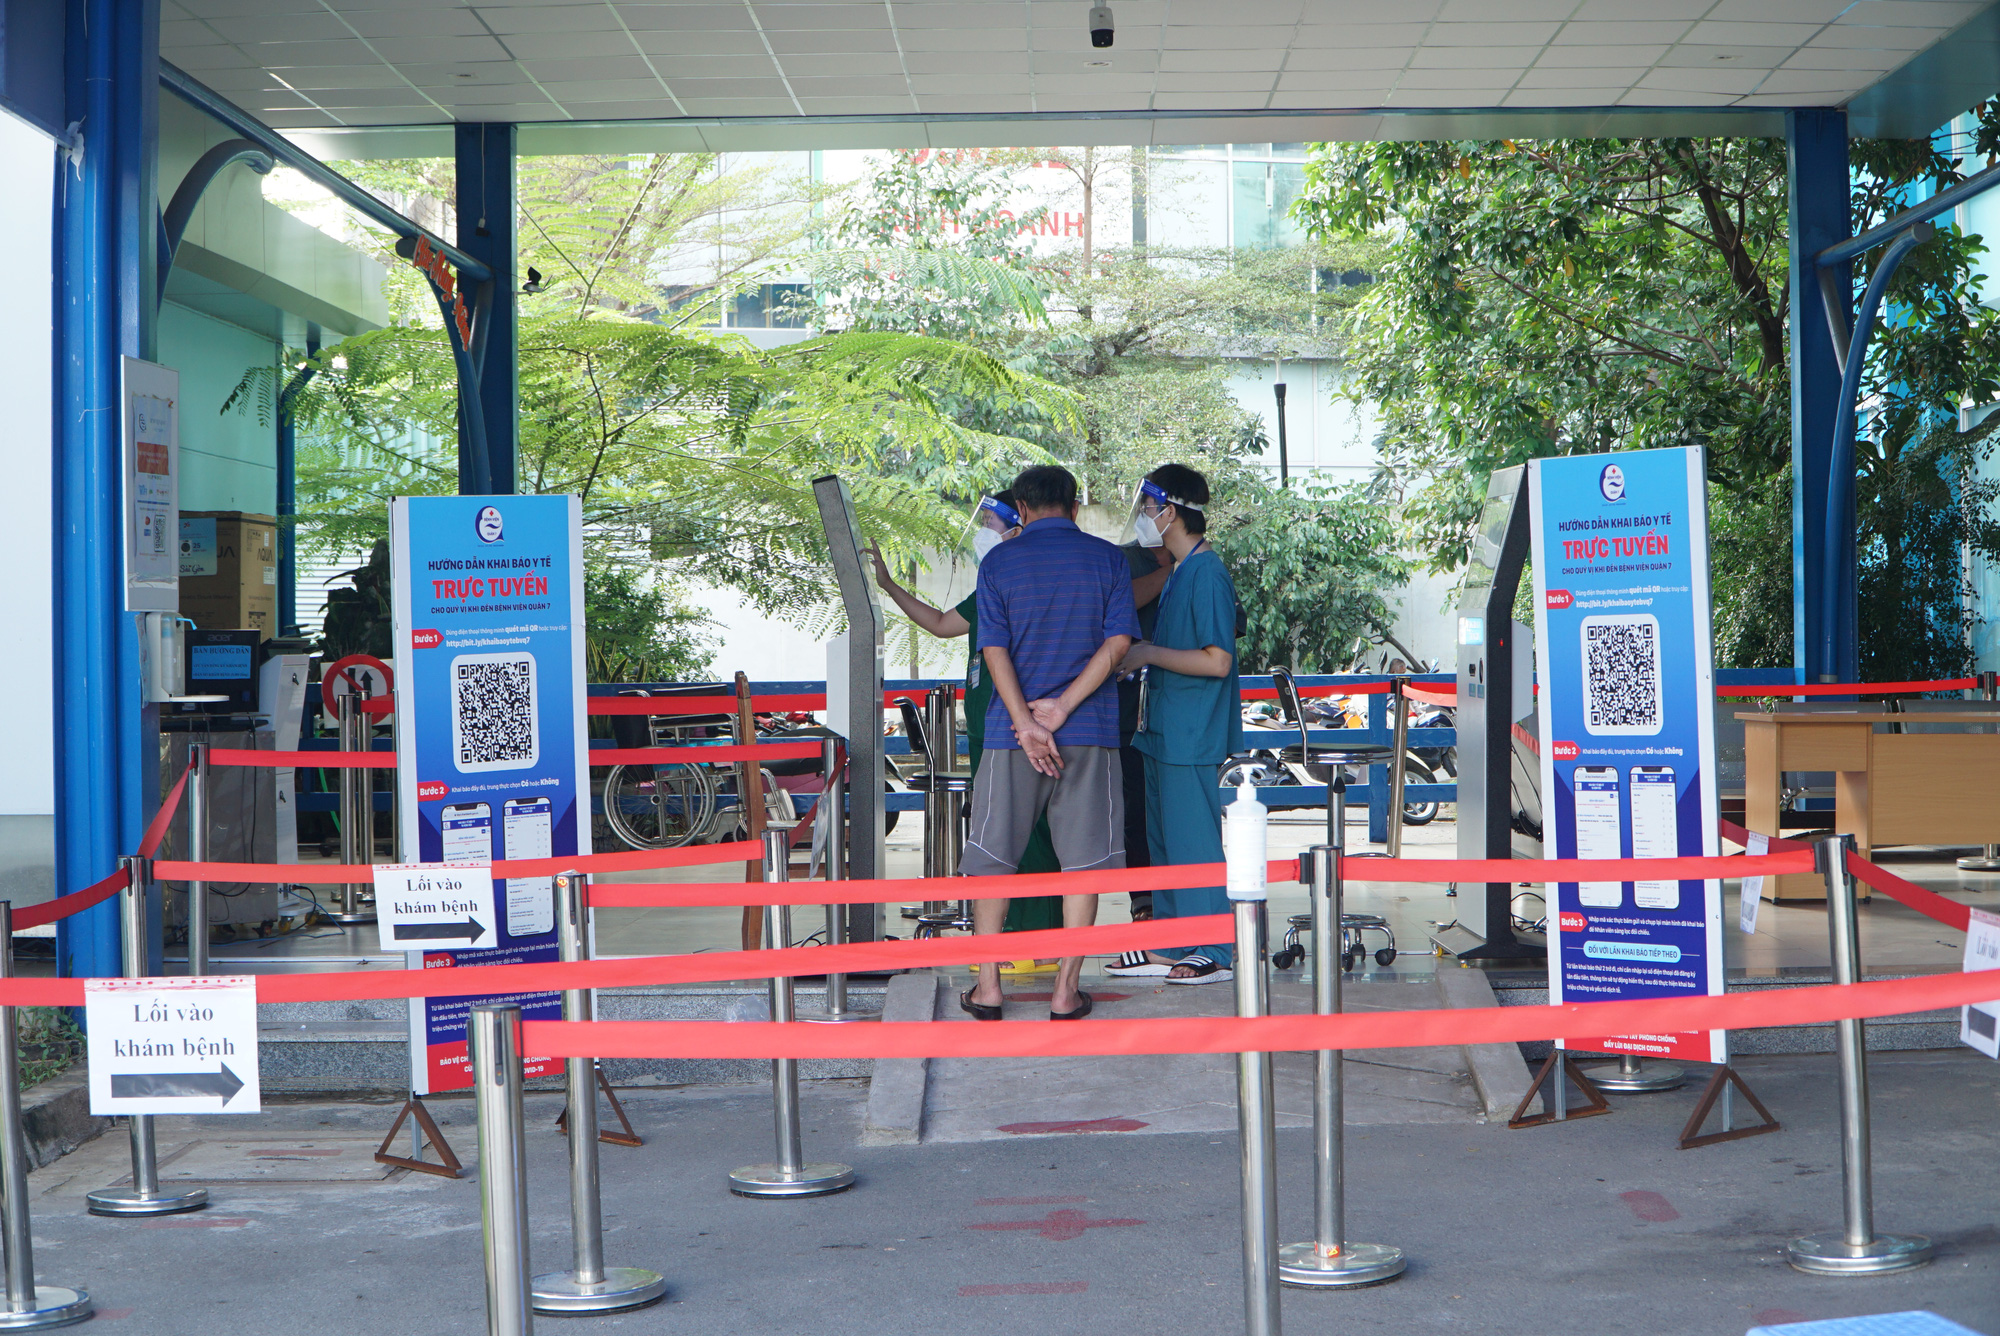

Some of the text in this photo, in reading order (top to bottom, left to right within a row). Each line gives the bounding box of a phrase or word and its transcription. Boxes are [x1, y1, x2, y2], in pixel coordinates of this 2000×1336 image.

[1559, 511, 1672, 532] HƯỚNG DẪN KHAI BÁO Y TẾ
[1562, 528, 1669, 564] TRỰC TUYẾN
[257, 547, 273, 562] AQUA
[428, 554, 551, 571] HƯỚNG DẪN KHAI BÁO Y TẾ
[1562, 561, 1672, 575] CHO QUÝ VỊ KHI ĐẾN BỆNH VIỆN QUẬN 7
[432, 570, 548, 604] TRỰC TUYẾN
[1629, 585, 1643, 595] quét
[1643, 585, 1652, 593] mã
[1652, 585, 1660, 593] QR
[1548, 594, 1569, 604] Bước 1
[431, 607, 445, 615] CHO
[446, 604, 459, 614] QUÝ
[460, 606, 468, 615] VỊ
[469, 605, 480, 613] KHI
[480, 602, 494, 613] ĐẾN
[495, 603, 512, 614] BỆNH
[512, 601, 528, 612] VIỆN
[528, 602, 546, 612] QUẬN
[505, 624, 519, 634] quét
[519, 624, 529, 632] mã
[529, 624, 539, 632] QR
[208, 634, 233, 642] acer
[414, 634, 438, 644] Bước 1
[1645, 746, 1654, 755] Có
[1664, 746, 1683, 757] Không
[520, 779, 529, 788] Có
[540, 777, 560, 787] Không
[407, 875, 462, 892] Lối vào
[394, 899, 478, 916] khám bệnh
[1561, 917, 1583, 927] Bước 3
[1588, 944, 1678, 958] ĐỐI VỚI LẦN KHAI BÁO TIẾP THEO
[1976, 931, 1999, 961] Lối vào
[426, 958, 445, 969] Bước
[445, 958, 451, 967] 3
[133, 998, 214, 1023] Lối vào
[114, 1036, 235, 1061] khám bệnh
[1603, 1039, 1671, 1053] ĐẨY LÙI ĐẠI DỊCH COVID-19
[460, 1055, 469, 1063] CH
